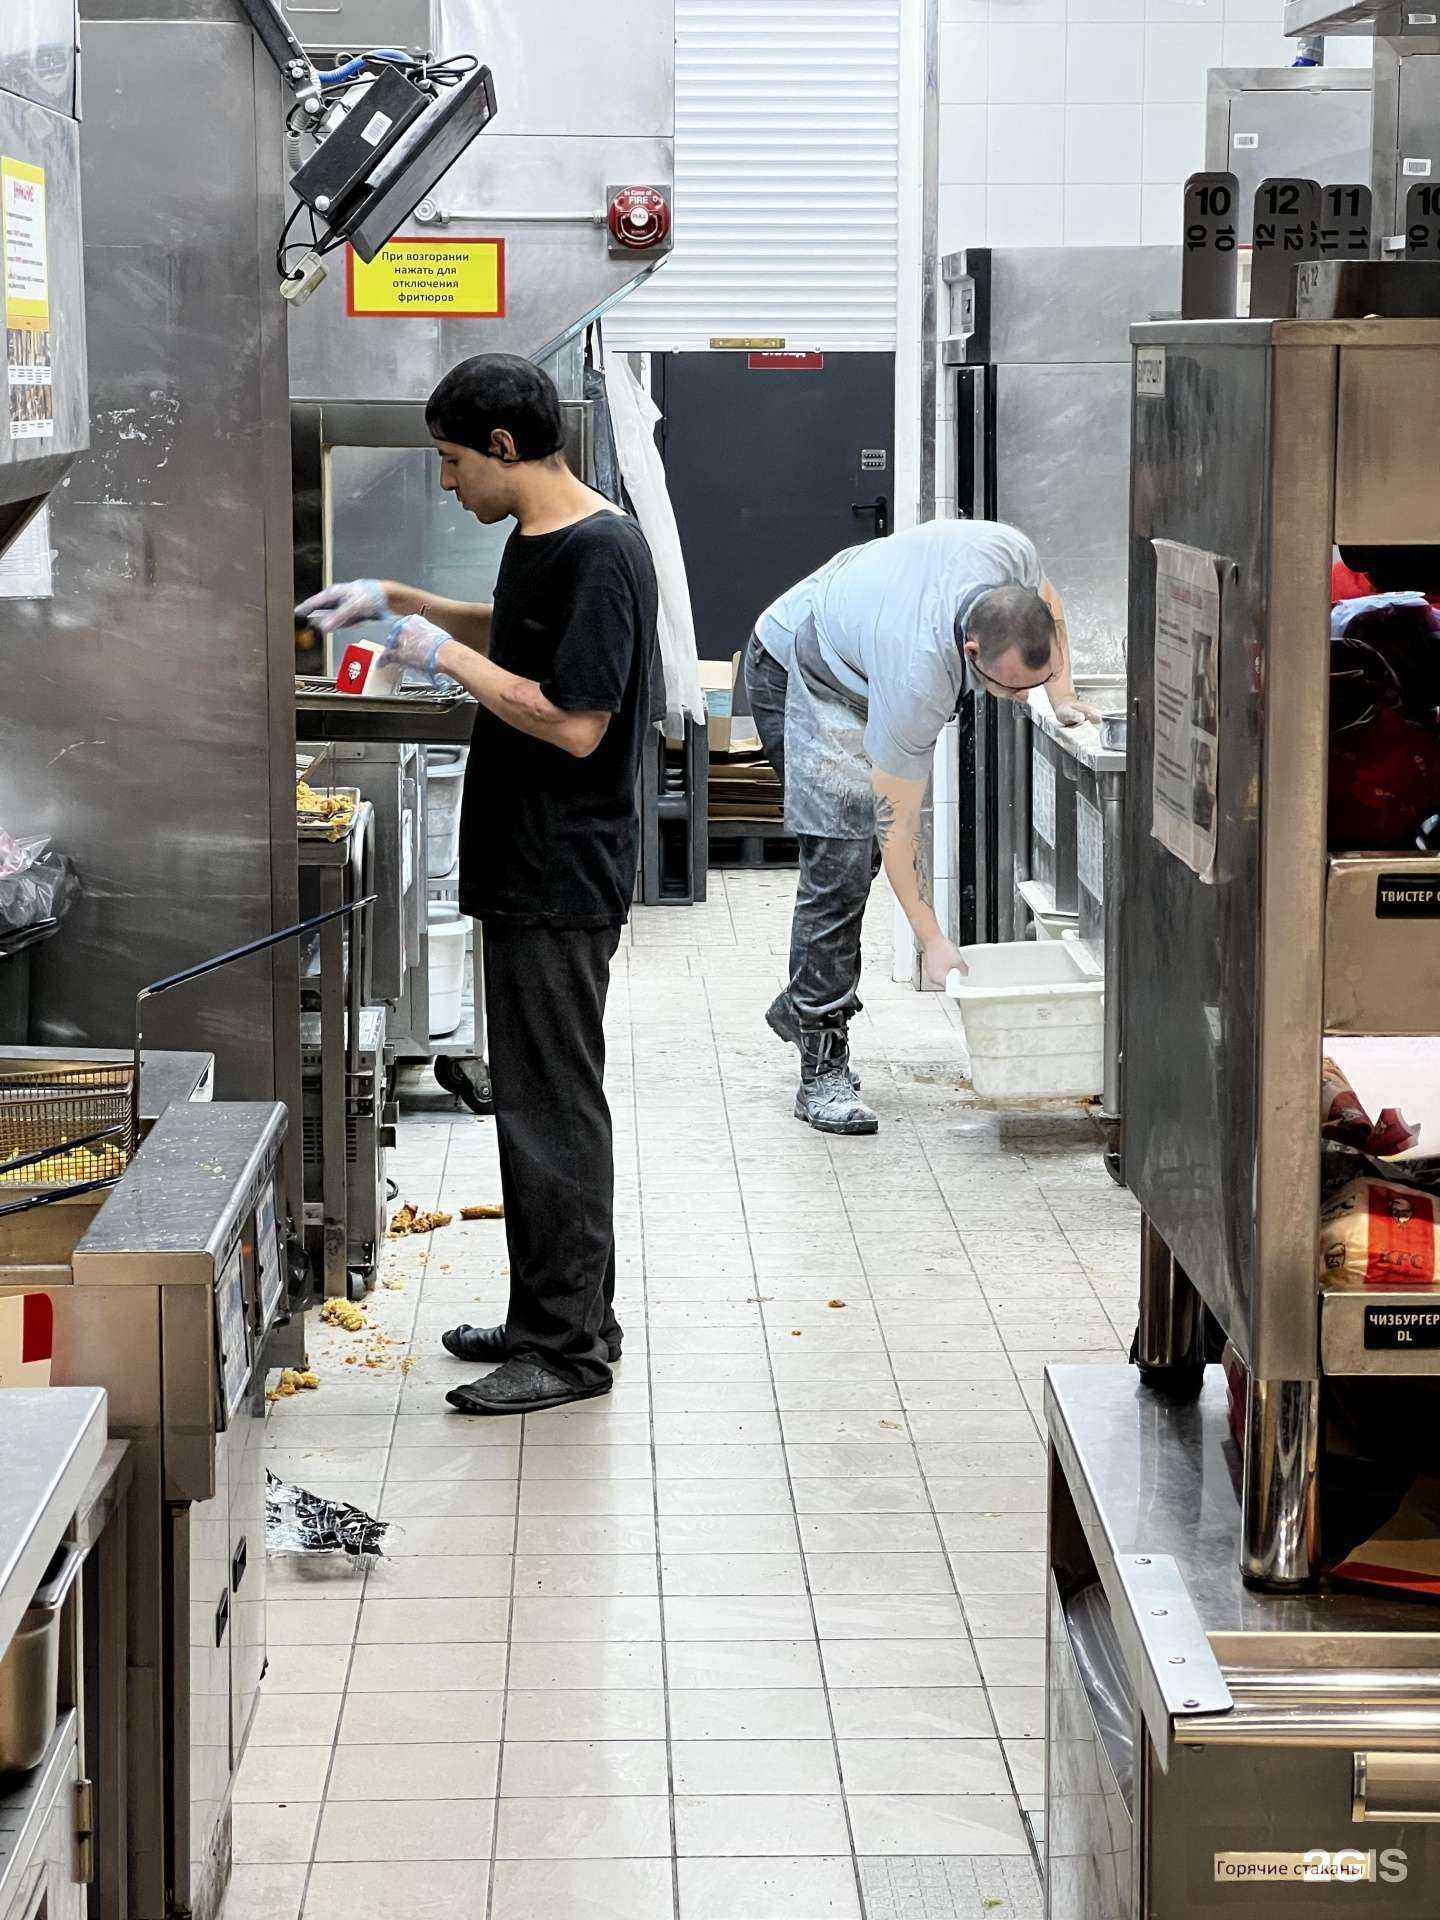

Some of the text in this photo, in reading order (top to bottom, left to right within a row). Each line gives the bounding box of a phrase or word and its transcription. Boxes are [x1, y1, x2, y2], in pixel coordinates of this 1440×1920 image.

[629, 196, 649, 204] FIRE
[1195, 186, 1231, 216] 10
[1264, 185, 1300, 214] 12
[1328, 188, 1360, 216] 11
[1187, 225, 1207, 252] 10
[1215, 225, 1235, 252] 10
[1256, 224, 1276, 251] 12
[1284, 224, 1304, 251] 12
[1320, 230, 1339, 253] 11
[1348, 226, 1368, 249] 11
[1409, 224, 1429, 252] 10
[381, 252, 470, 263] При возгорании
[394, 266, 457, 277] нажать для
[392, 280, 459, 288] отключения
[398, 292, 454, 304] фритюров
[1381, 890, 1434, 902] ТВИСТЕР
[1369, 1314, 1440, 1326] ЧИЗБУРГЕР
[1397, 1330, 1413, 1342] DL
[1217, 1860, 1364, 1877] Горячие стаканы
